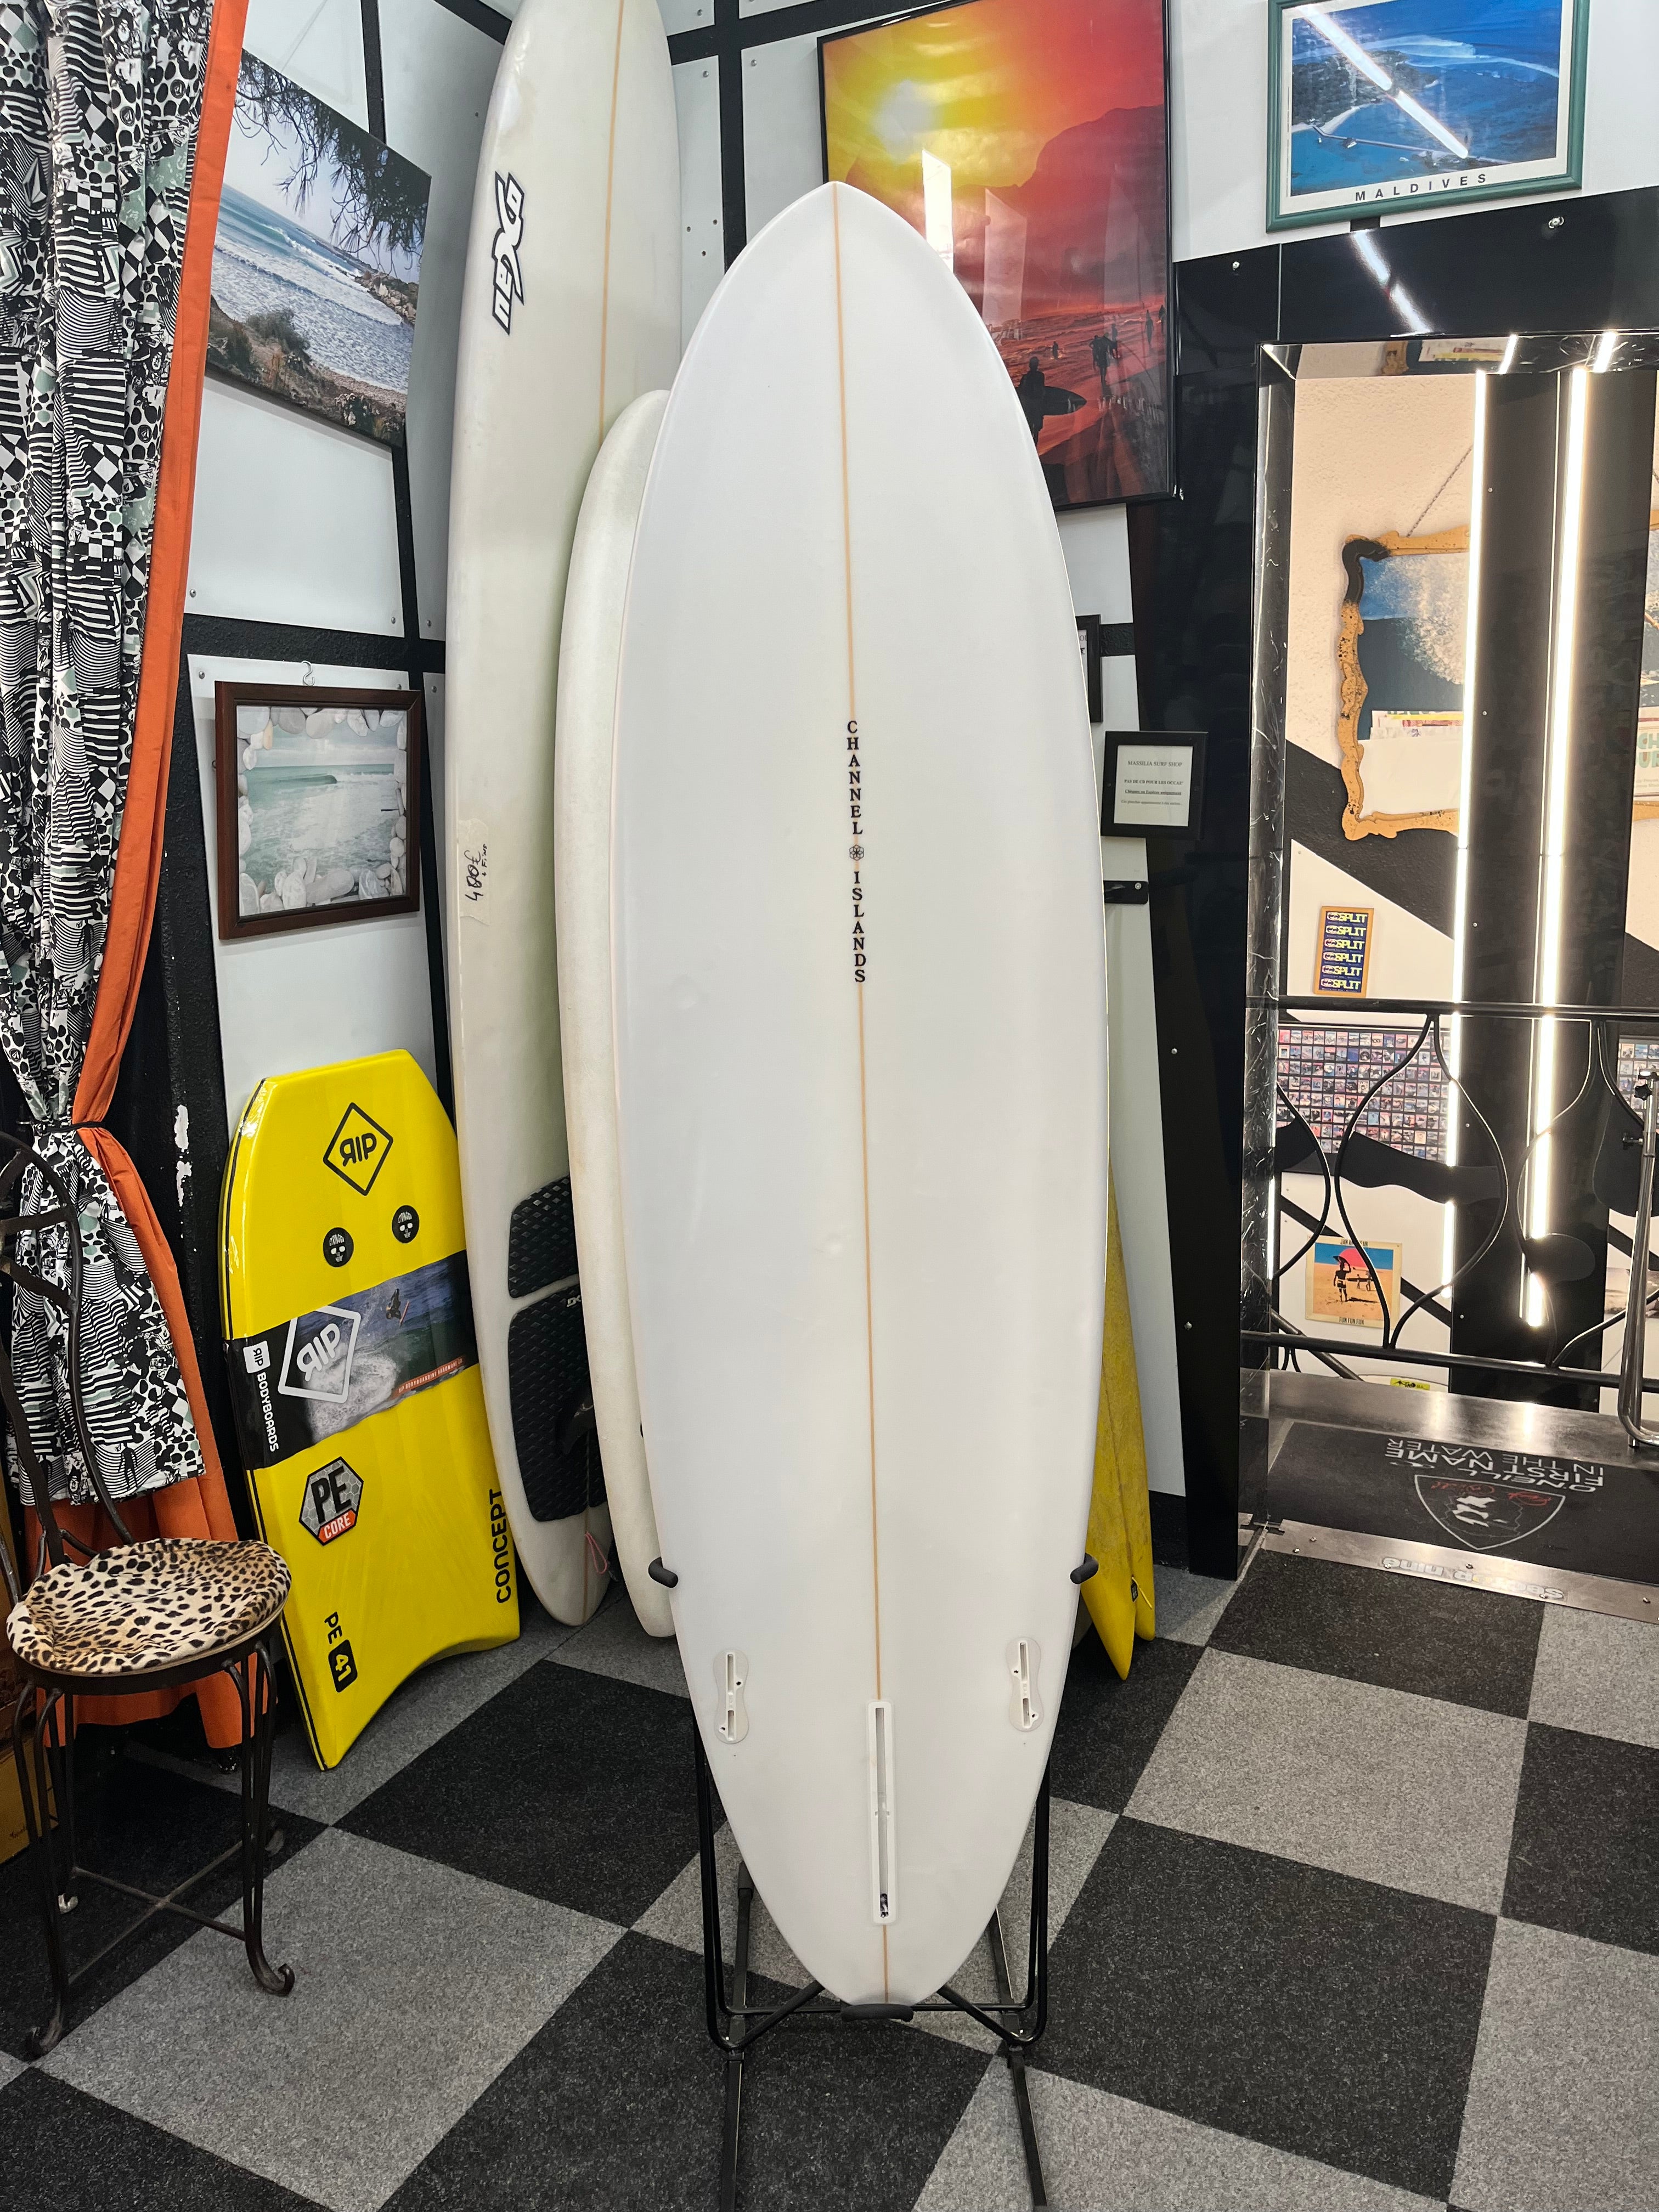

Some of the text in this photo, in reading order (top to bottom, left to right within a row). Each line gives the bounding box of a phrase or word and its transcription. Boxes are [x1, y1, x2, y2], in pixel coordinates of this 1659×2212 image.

[1355, 173, 1487, 201] MALDIVES
[847, 720, 866, 983] CHANNEL ISLANDS
[1338, 926, 1367, 936] SPLIT
[1339, 913, 1367, 923] SPLIT
[1335, 952, 1363, 963] SPLIT
[1337, 939, 1365, 950] SPLIT
[1333, 979, 1361, 990] SPLIT
[1334, 966, 1362, 976] SPLIT
[257, 1372, 279, 1452] BODYBOARDS
[1384, 1447, 1604, 1487] FIRST NAME
[1387, 1438, 1604, 1476] IN THE WATER
[311, 1466, 351, 1524] PE
[323, 1512, 352, 1539] CORE
[324, 1611, 350, 1683] PE 41
